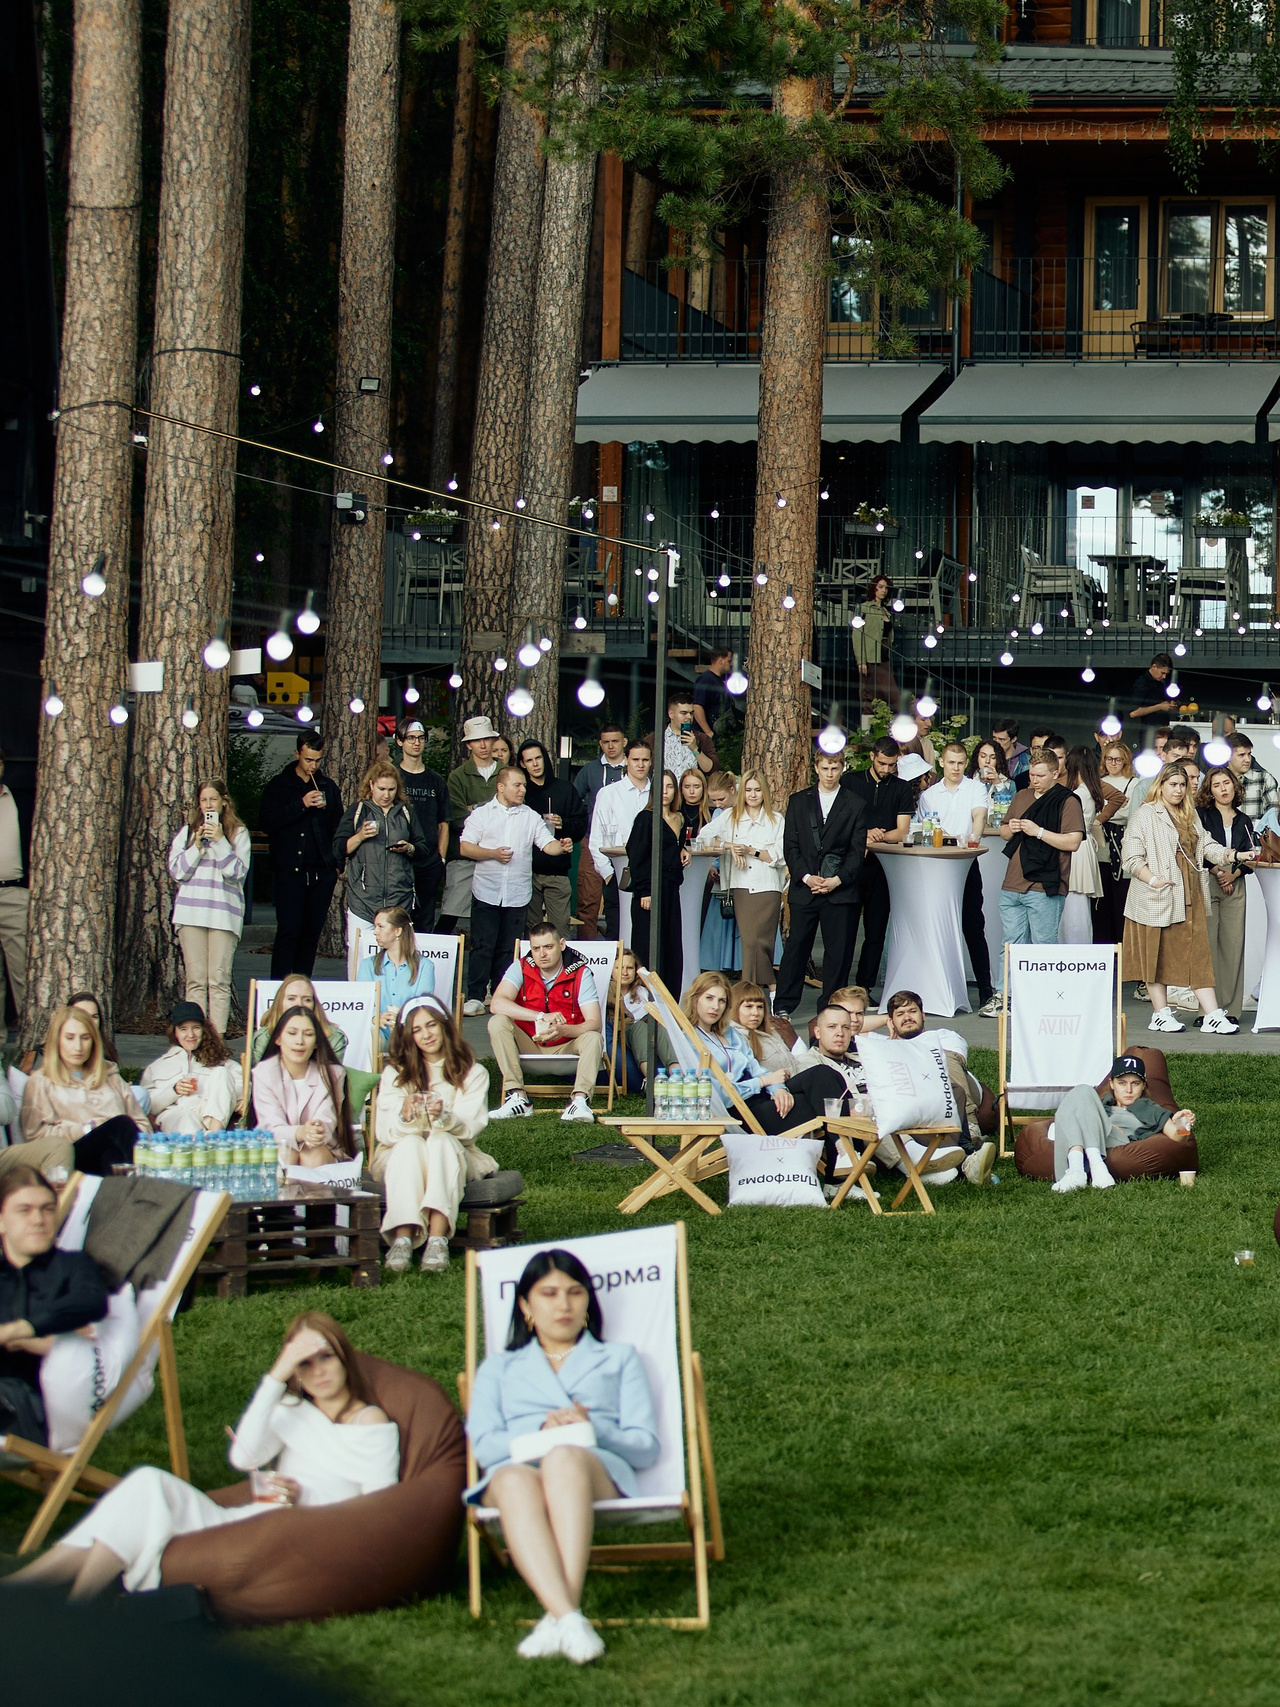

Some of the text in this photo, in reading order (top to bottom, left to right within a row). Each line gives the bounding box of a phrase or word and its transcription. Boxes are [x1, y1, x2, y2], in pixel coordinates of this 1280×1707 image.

[402, 786, 437, 798] SENTIALS
[1018, 960, 1107, 974] Платформа
[267, 998, 364, 1012] Порма
[1123, 1058, 1137, 1068] 71
[738, 1172, 818, 1187] Платформа
[499, 1264, 661, 1300] Порма
